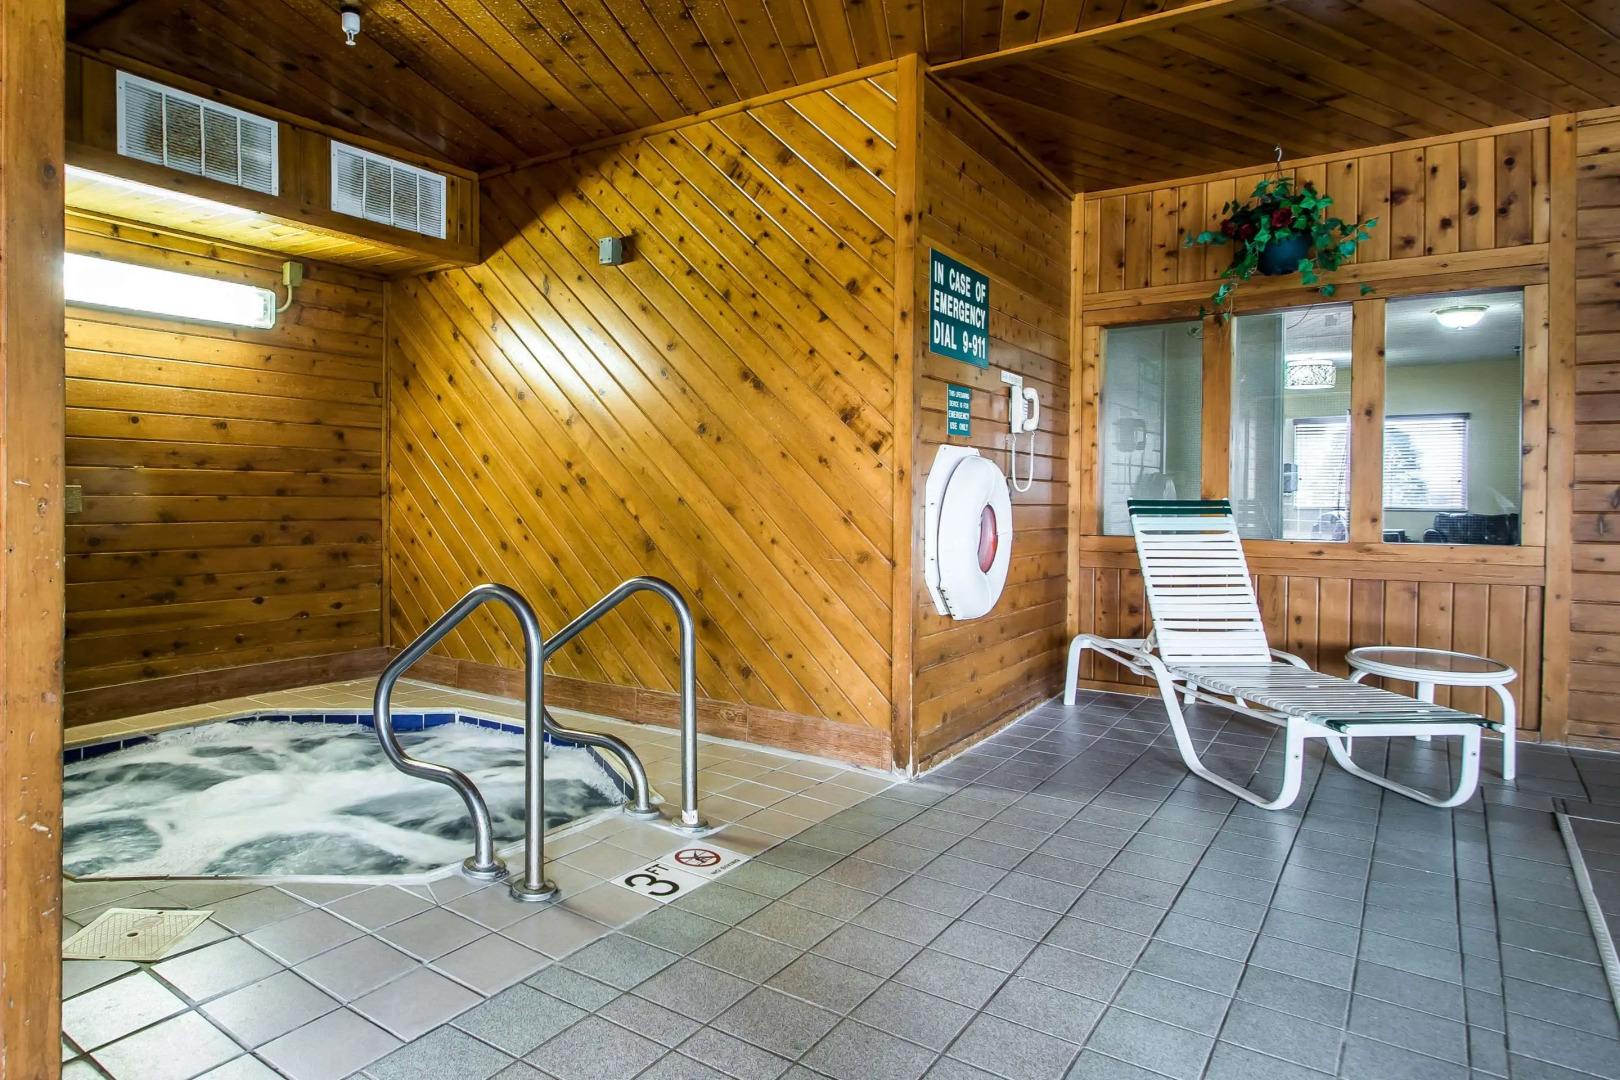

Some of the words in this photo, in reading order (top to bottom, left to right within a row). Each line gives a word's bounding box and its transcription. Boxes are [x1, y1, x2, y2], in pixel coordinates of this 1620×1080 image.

[934, 261, 944, 286] IN
[949, 268, 971, 298] CASE
[975, 281, 986, 304] OF
[933, 288, 986, 330] EMERGENCY
[933, 319, 957, 350] DIAL
[962, 330, 986, 360] 9-911
[949, 410, 970, 420] EMERGENCY
[949, 422, 958, 430] USE
[959, 423, 968, 431] ONLY
[644, 863, 670, 876] FT
[624, 873, 680, 897] 3
